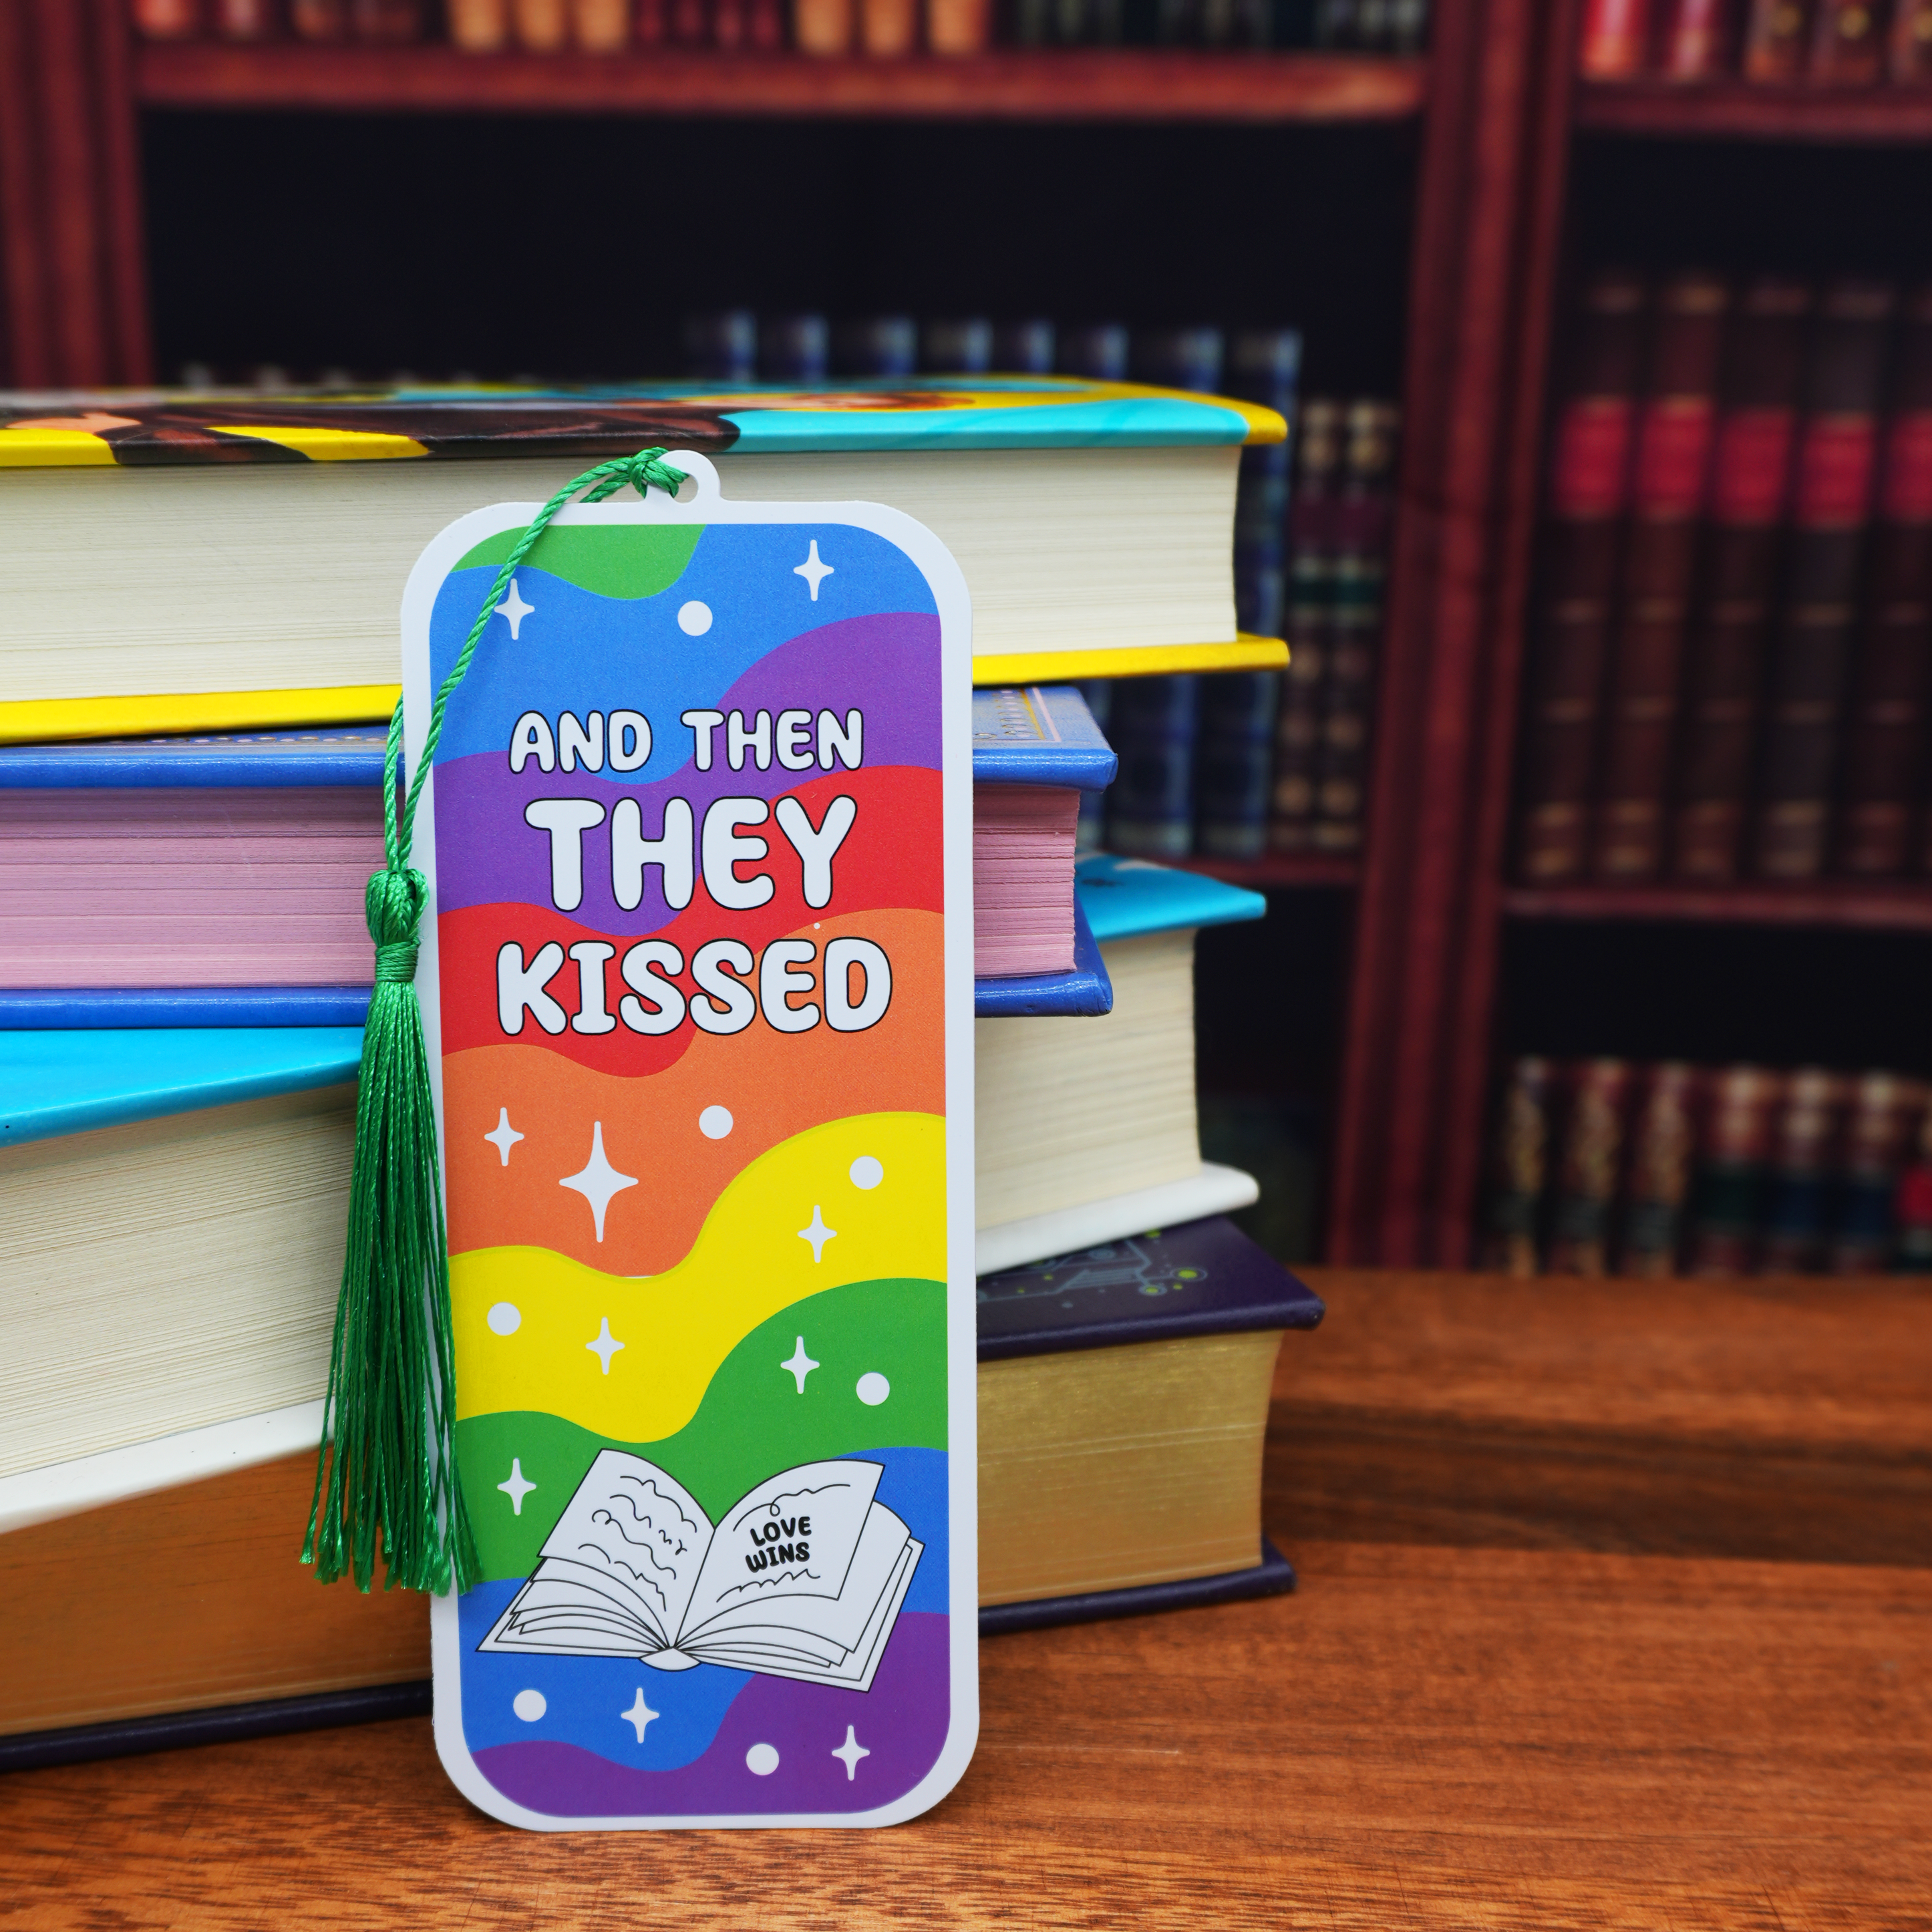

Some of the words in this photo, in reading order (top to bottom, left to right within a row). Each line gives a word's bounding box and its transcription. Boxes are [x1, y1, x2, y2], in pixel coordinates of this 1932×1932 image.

[509, 709, 653, 774] AND
[680, 708, 864, 772] THEN
[524, 794, 858, 912] THEY
[496, 937, 893, 1036] KISSED
[745, 1542, 810, 1573] WINS
[750, 1516, 812, 1547] LOVE
